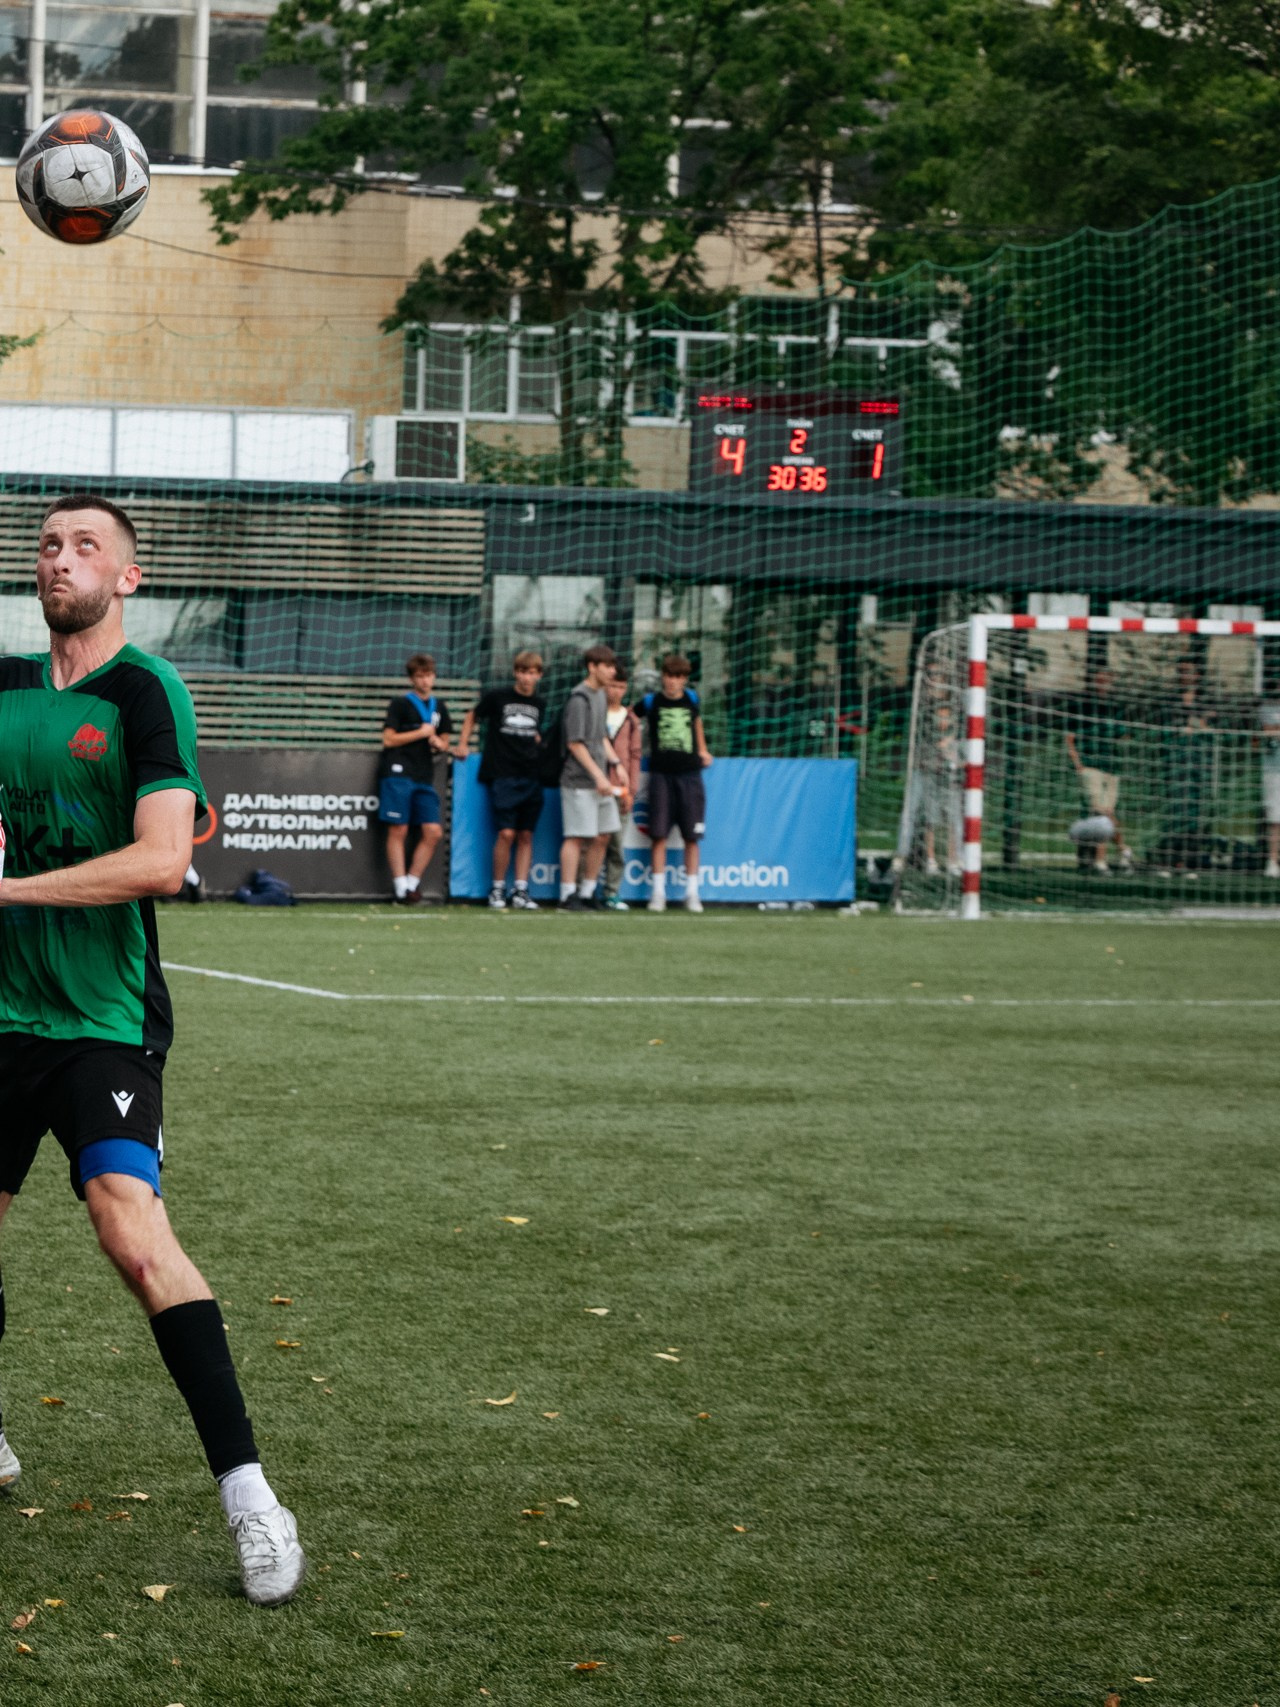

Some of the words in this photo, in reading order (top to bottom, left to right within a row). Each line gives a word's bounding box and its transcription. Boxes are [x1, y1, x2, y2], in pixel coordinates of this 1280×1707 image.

[789, 429, 808, 454] 2
[720, 437, 747, 475] 4
[871, 443, 885, 480] 1
[223, 812, 367, 831] ФУТБОЛЬНАЯ
[222, 833, 352, 852] МЕДИАЛИГА
